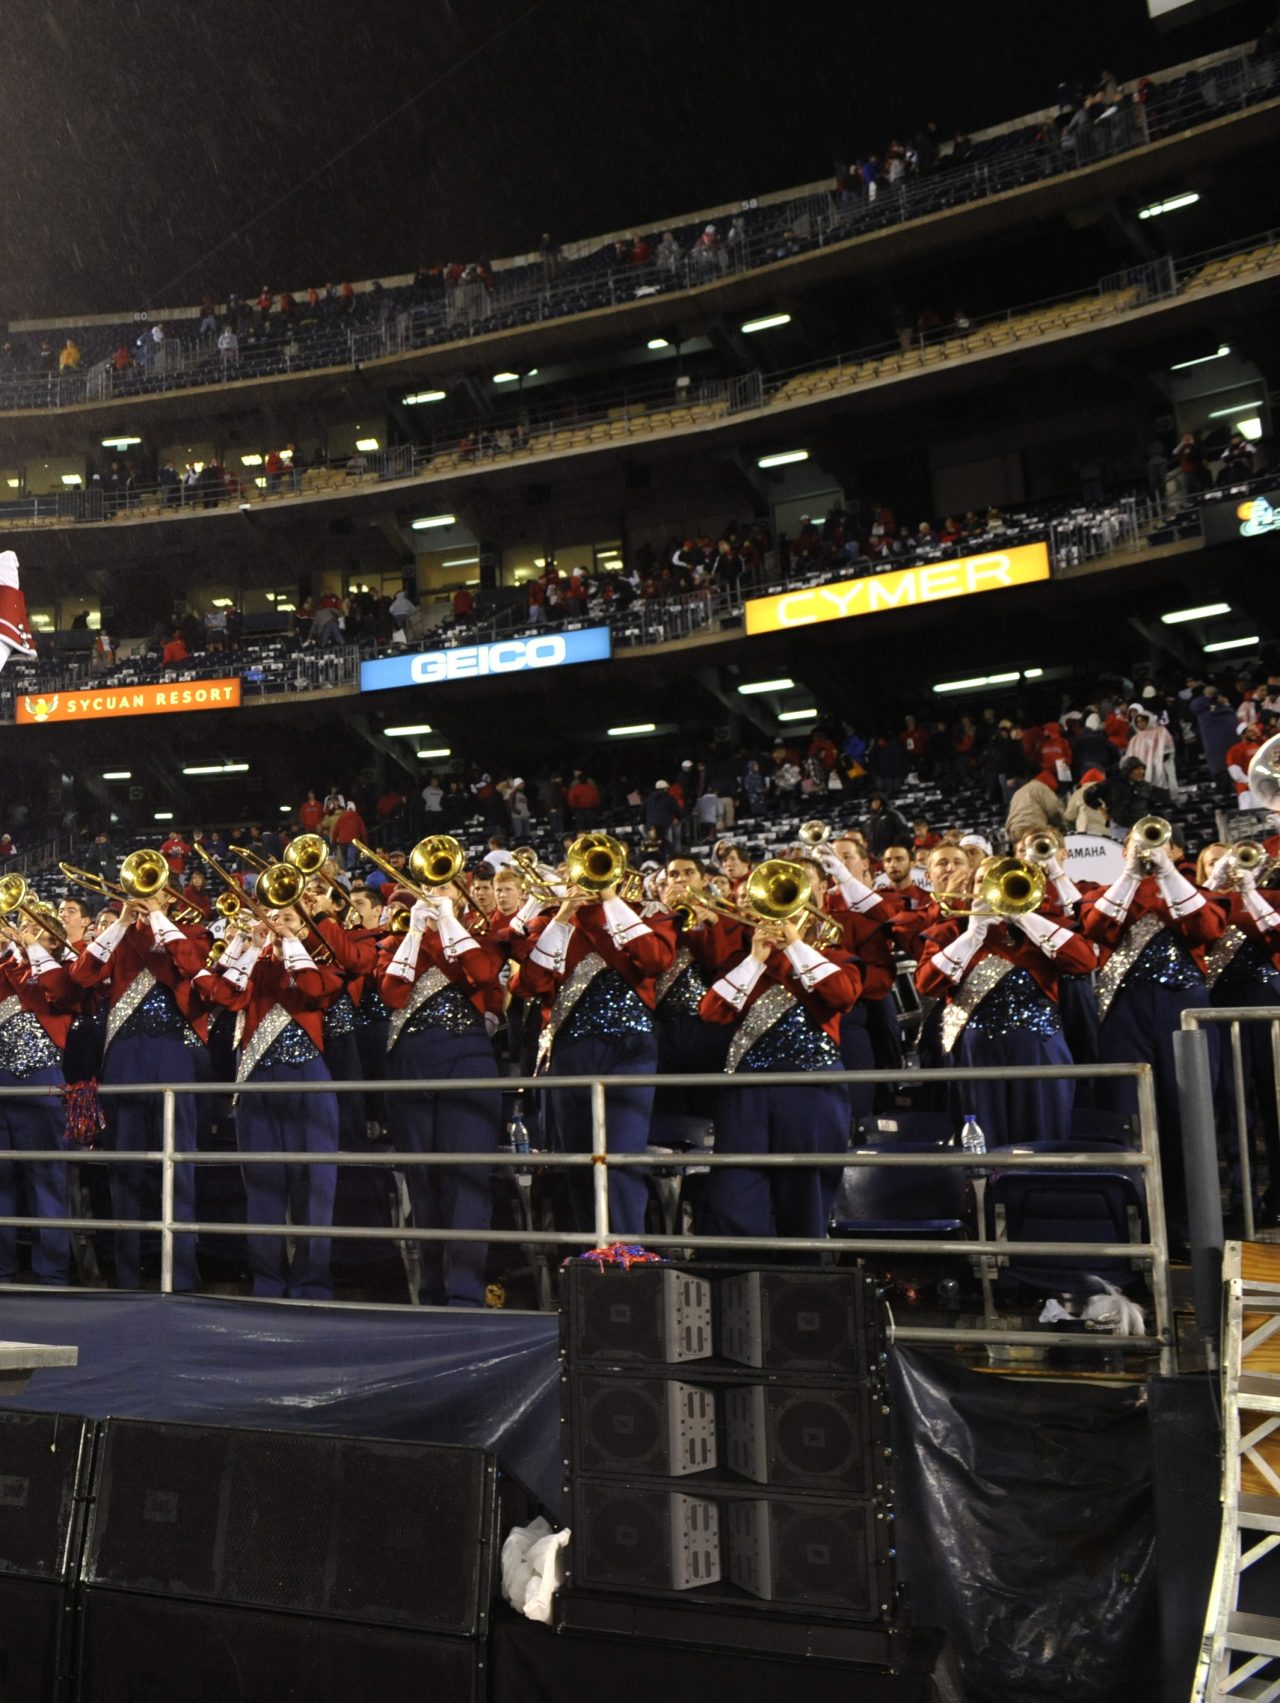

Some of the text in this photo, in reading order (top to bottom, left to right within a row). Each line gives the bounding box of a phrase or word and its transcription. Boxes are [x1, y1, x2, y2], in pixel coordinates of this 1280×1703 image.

[777, 553, 1013, 627] CYMER
[410, 635, 566, 684] GEICO
[67, 686, 233, 713] SYCUAN RESORT
[1068, 846, 1107, 859] AMAHA
